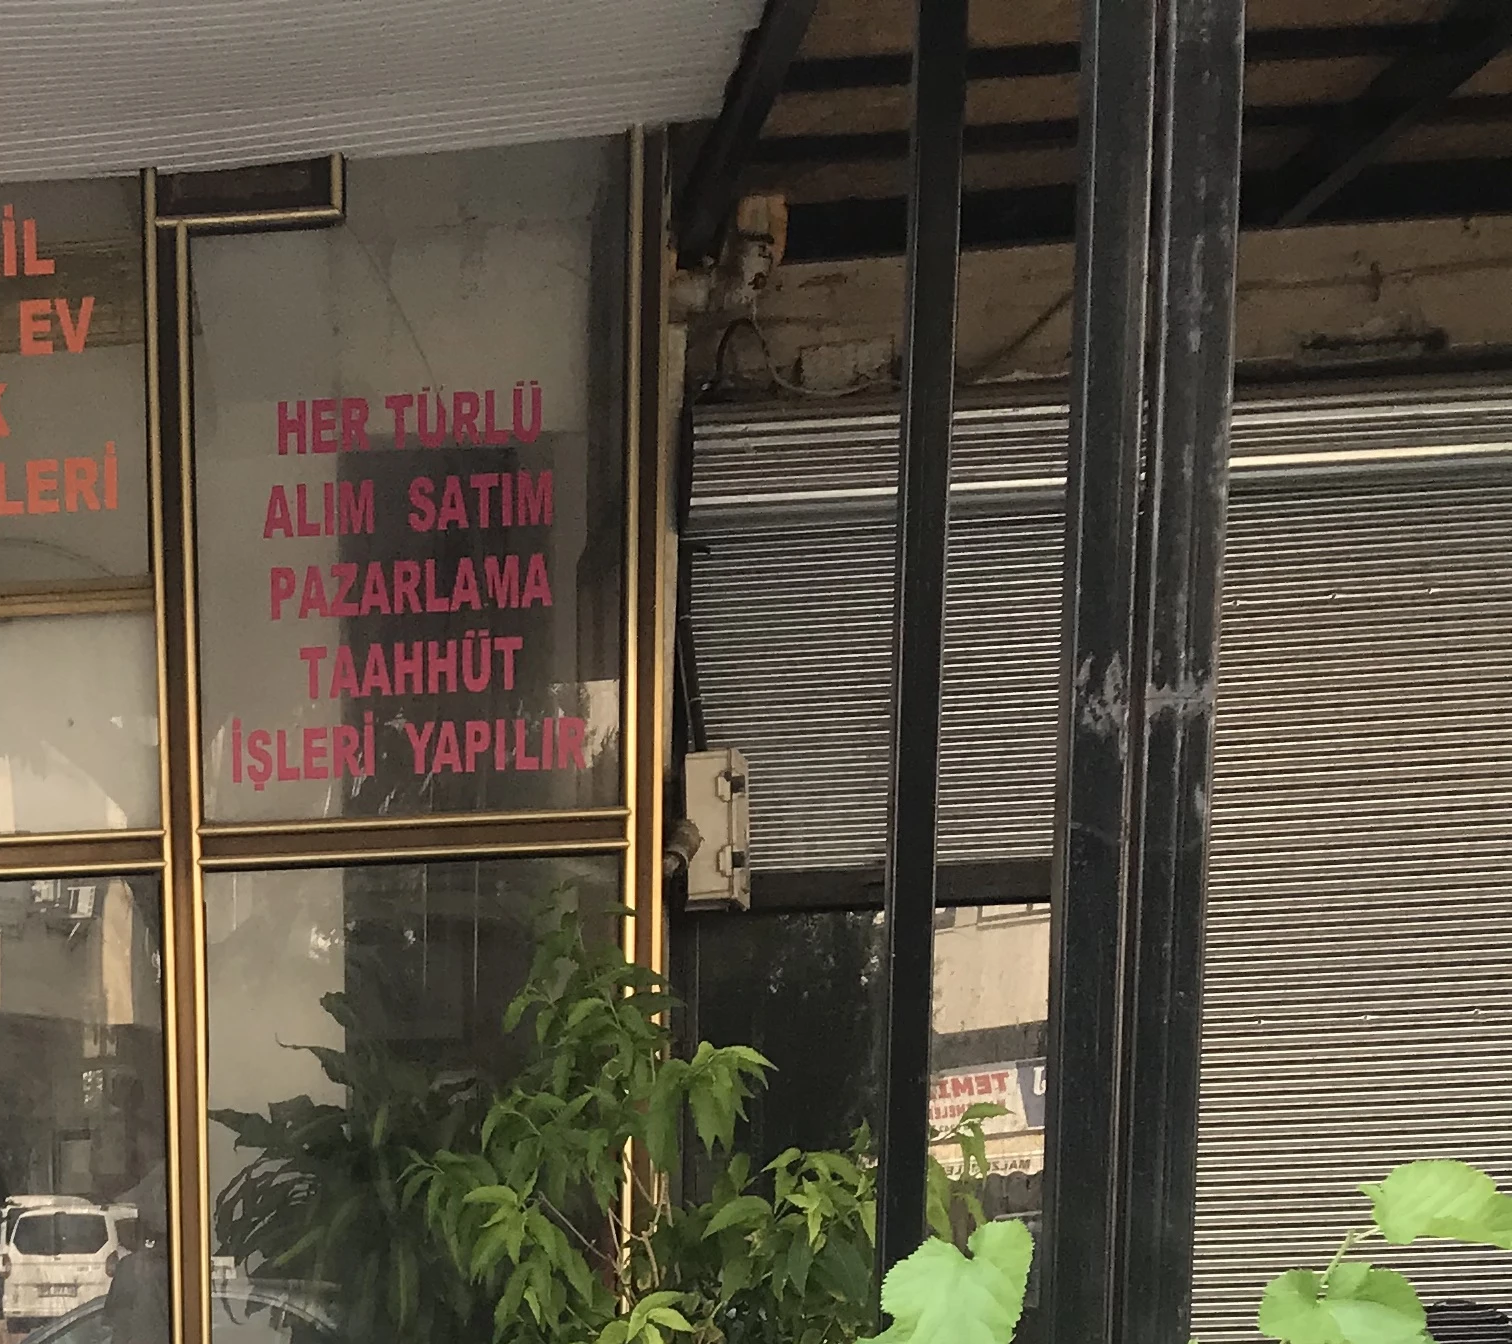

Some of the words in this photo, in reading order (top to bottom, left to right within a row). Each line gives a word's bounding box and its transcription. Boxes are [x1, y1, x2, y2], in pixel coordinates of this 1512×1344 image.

[19, 297, 95, 356] EV
[277, 397, 370, 455] HER
[385, 380, 543, 450] TÜRLÜ
[263, 480, 375, 539] ALIM
[408, 469, 553, 532] SATIM
[270, 553, 553, 620] PAZARLAMA
[299, 629, 523, 699] TAAHHÜT
[231, 710, 375, 791] İŞLERİ
[403, 715, 587, 775] YAPILIR
